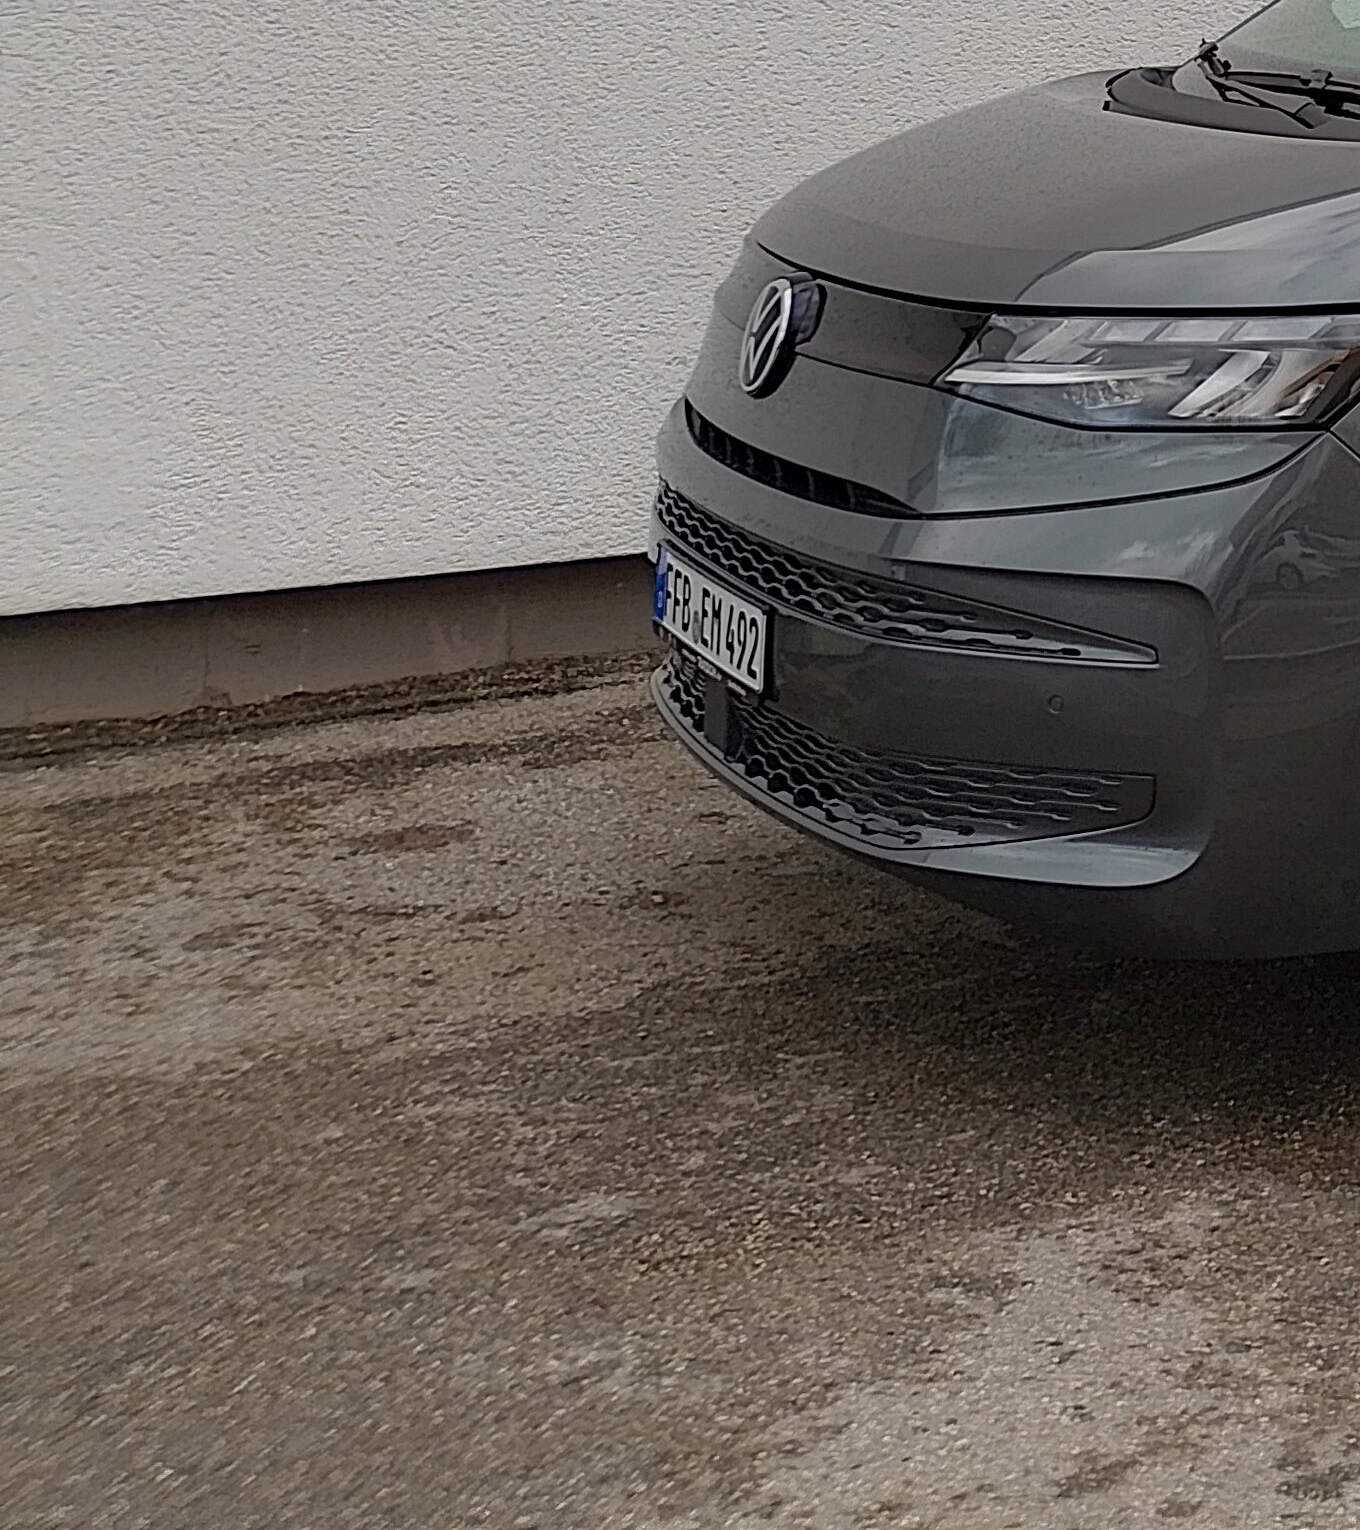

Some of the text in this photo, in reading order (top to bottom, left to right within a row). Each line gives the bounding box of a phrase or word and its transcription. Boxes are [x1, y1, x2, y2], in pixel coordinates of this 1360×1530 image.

[664, 563, 692, 633] FFB
[700, 586, 722, 656] EM
[725, 604, 760, 680] 492
